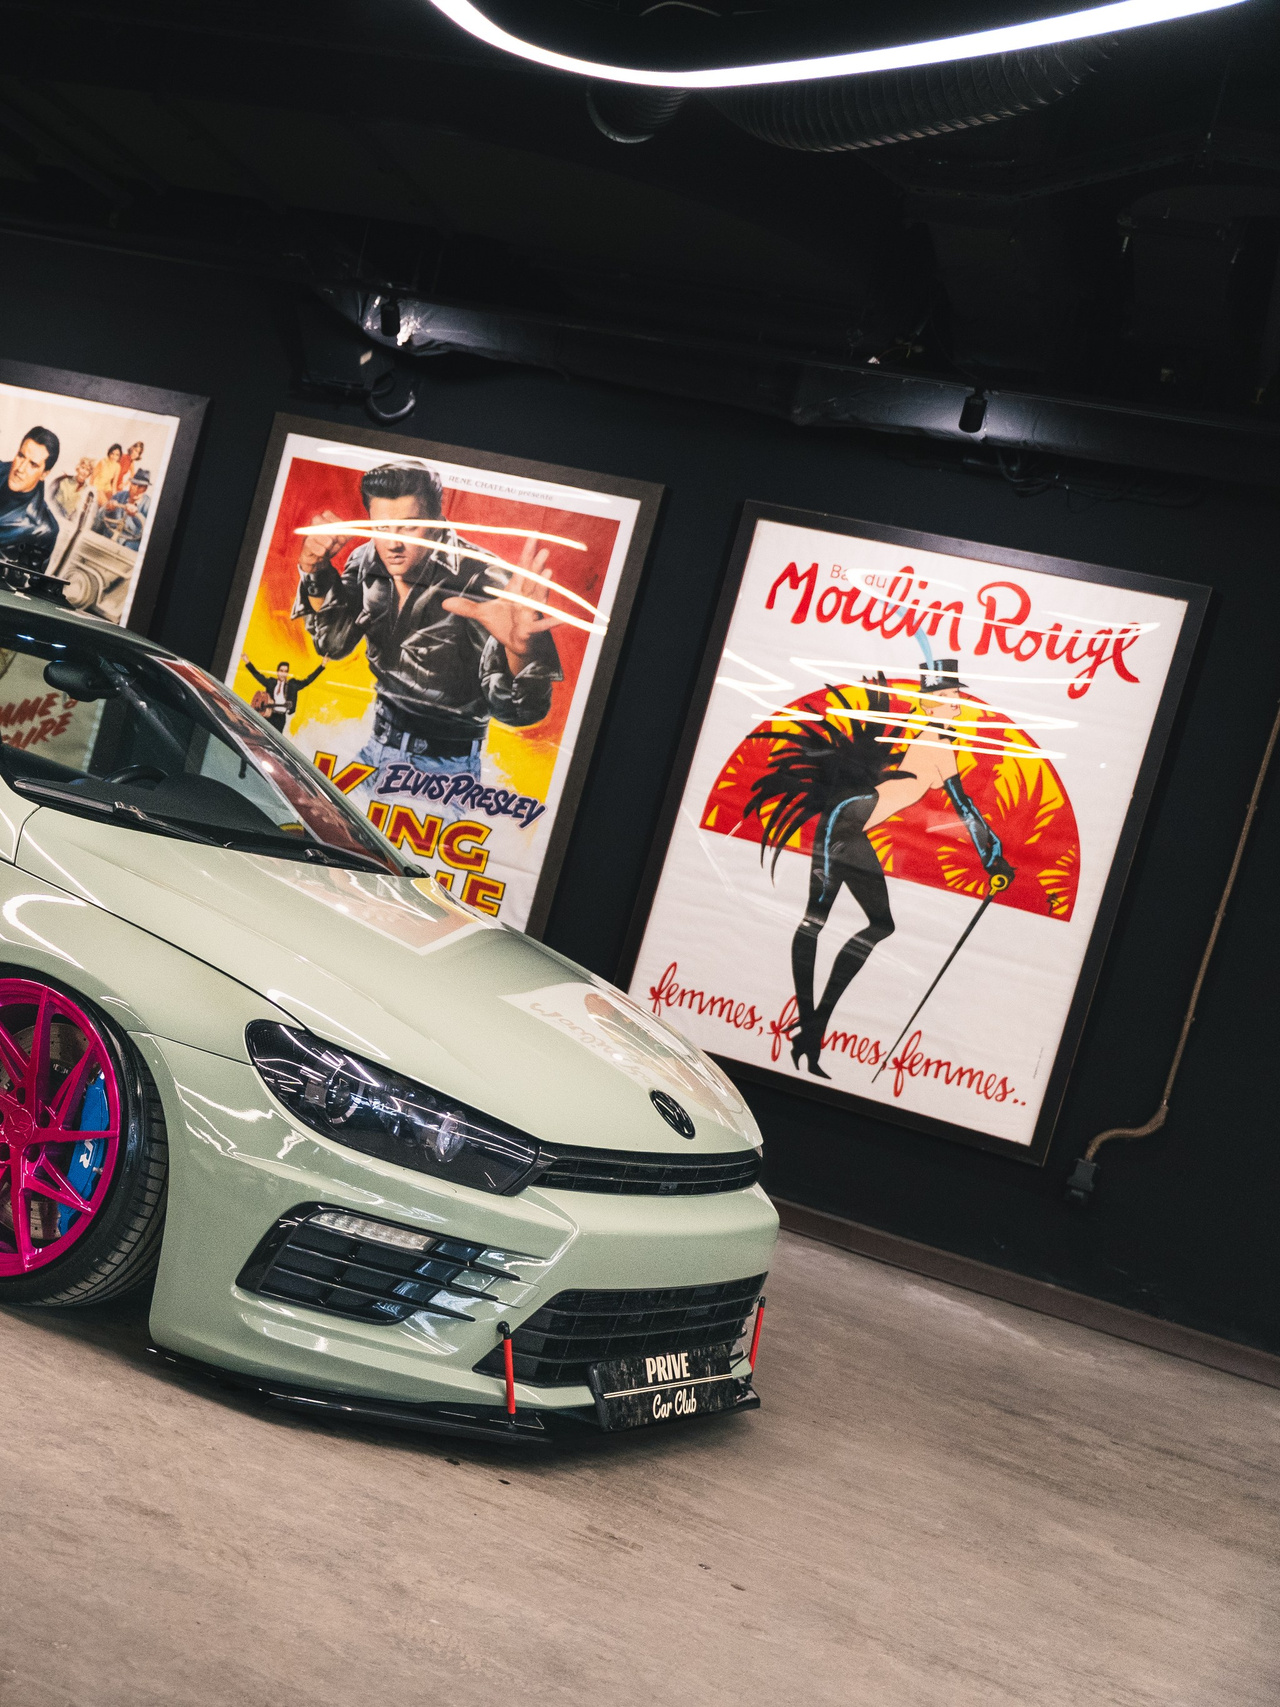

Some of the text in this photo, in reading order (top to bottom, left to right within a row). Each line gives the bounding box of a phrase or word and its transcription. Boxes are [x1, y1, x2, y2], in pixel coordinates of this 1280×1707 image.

[865, 572, 888, 589] du
[765, 561, 1141, 699] Moulin Rouge
[1, 711, 74, 750] AIRE
[377, 763, 548, 830] ELVIS PRESLEY
[648, 961, 764, 1035] femmes,
[645, 1352, 691, 1383] PRIVE
[652, 1387, 697, 1419] Car Club
